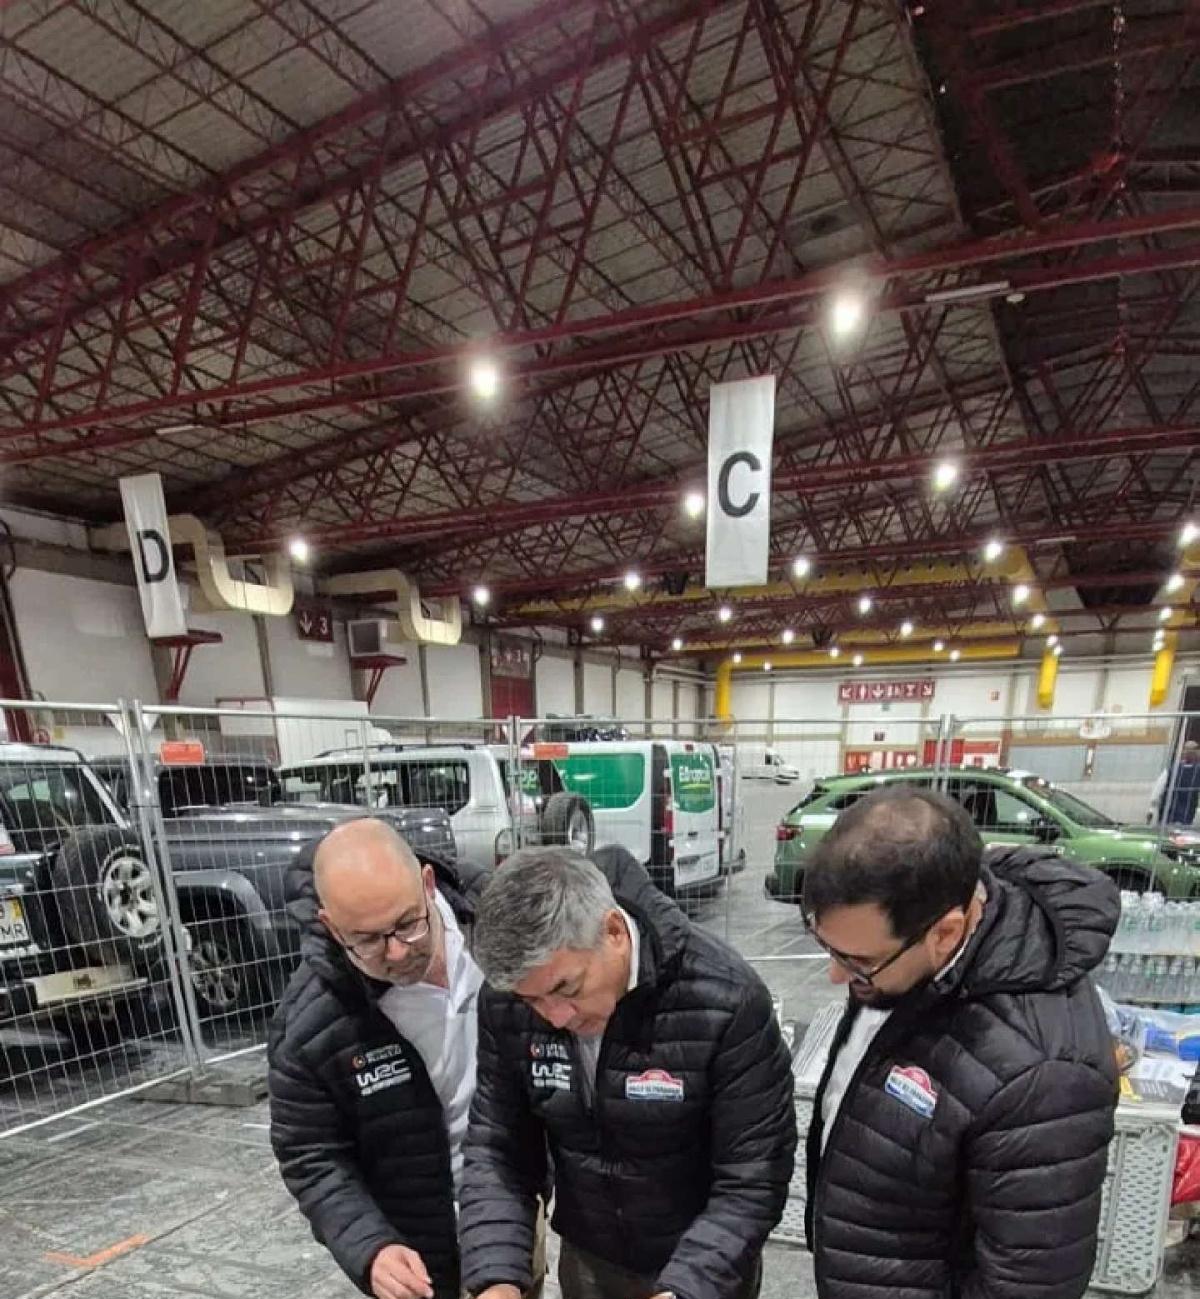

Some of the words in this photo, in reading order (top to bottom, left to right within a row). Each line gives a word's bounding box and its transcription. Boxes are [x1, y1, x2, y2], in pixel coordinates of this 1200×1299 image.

[718, 450, 762, 518] C
[136, 528, 170, 584] D
[319, 616, 328, 635] 3
[355, 1058, 410, 1088] WRC
